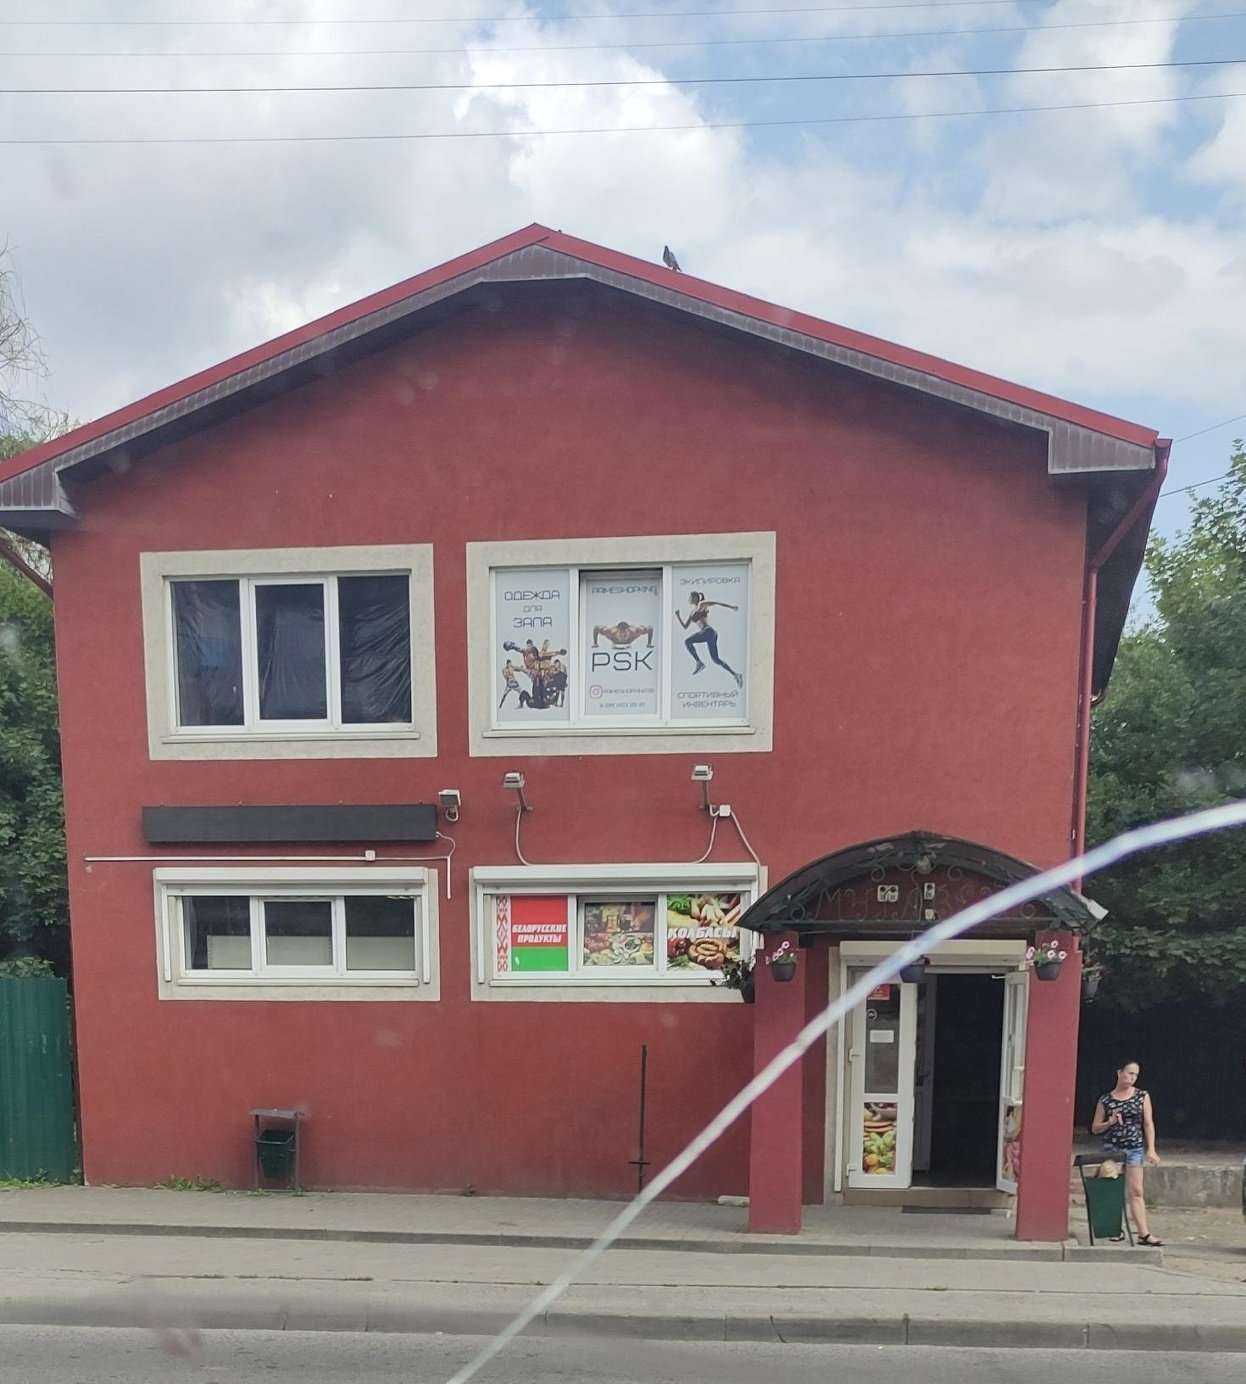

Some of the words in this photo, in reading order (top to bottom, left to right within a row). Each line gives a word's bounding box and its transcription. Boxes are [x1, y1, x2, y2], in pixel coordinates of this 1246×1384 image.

[679, 576, 741, 585] ЭКИПИРОВКА
[504, 590, 560, 601] ОДЕЖДА
[512, 616, 553, 628] ЗАЛА
[591, 650, 653, 672] PSK
[677, 689, 739, 699] СПОРТИВНЫЙ
[681, 700, 737, 709] ИНВЕНТАРЬ
[667, 926, 738, 939] КОЛБАСЫ
[517, 934, 562, 944] ПРОДУКТЫ
